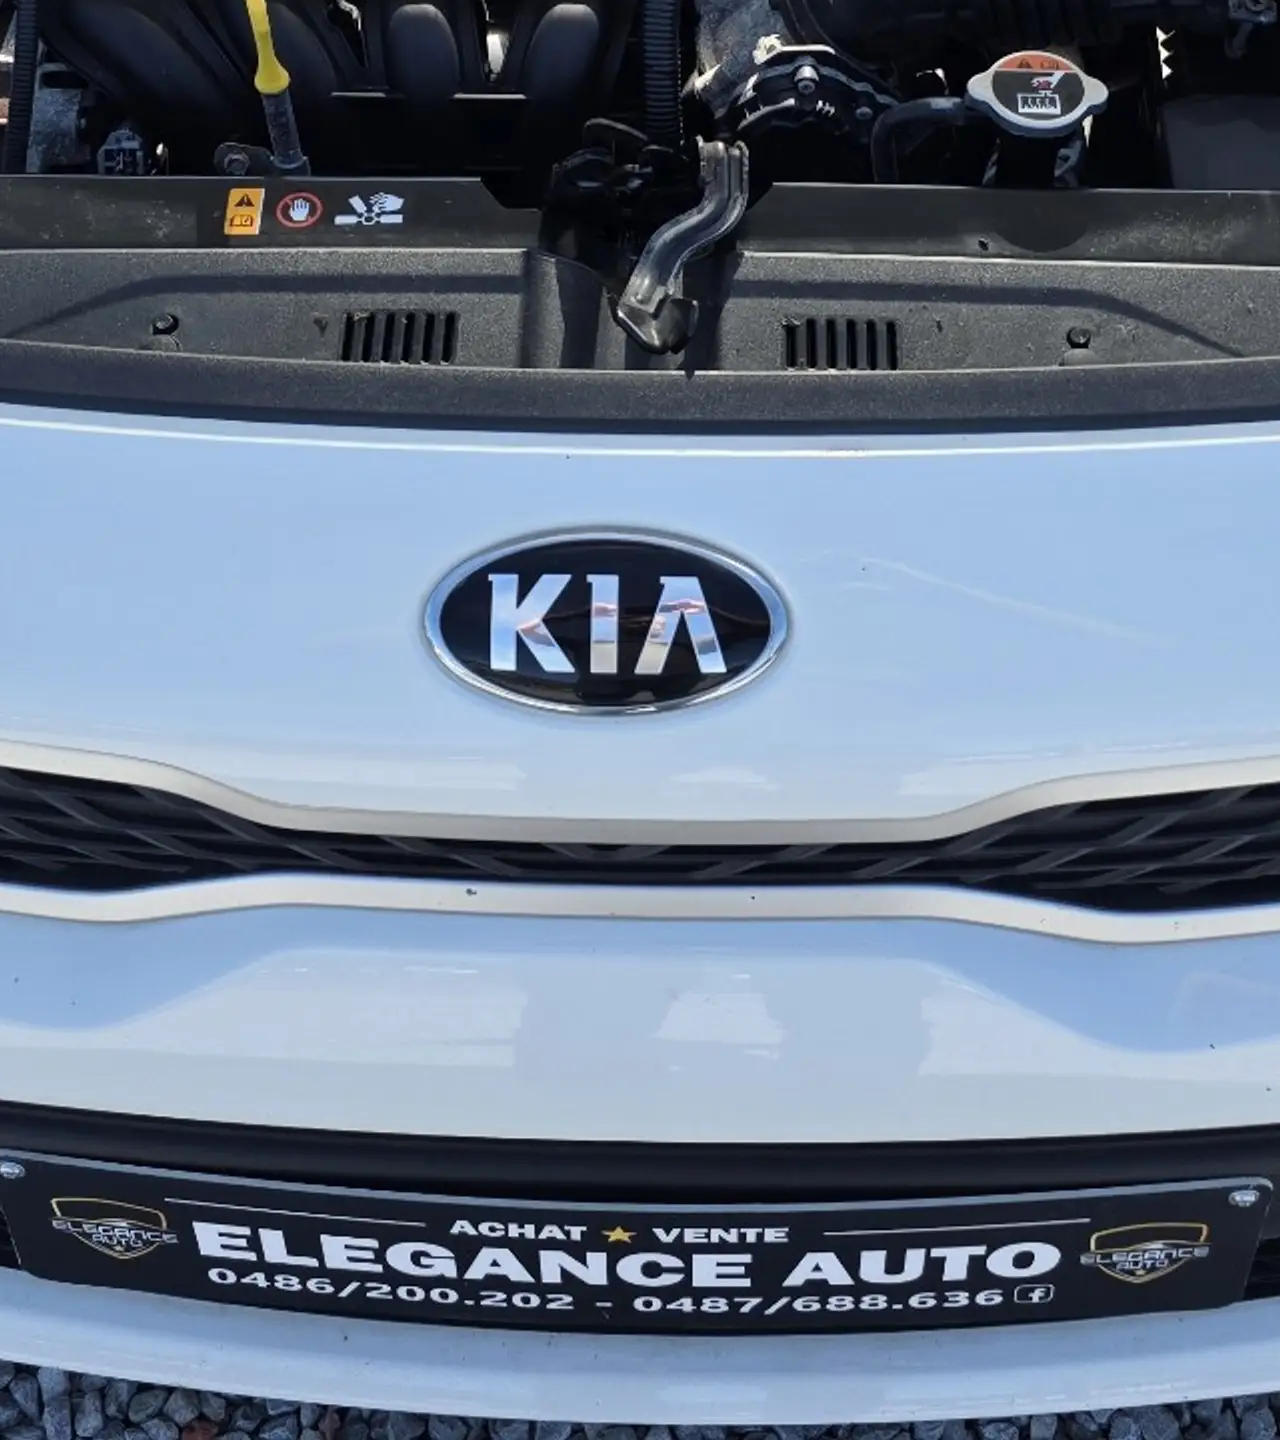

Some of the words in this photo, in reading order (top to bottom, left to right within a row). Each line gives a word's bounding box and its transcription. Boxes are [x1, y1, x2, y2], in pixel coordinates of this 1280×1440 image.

[488, 573, 727, 674] KIA
[192, 1221, 753, 1287] ELEGANCE
[782, 1241, 1062, 1288] AUTO
[450, 1219, 587, 1241] ACHAT
[652, 1227, 790, 1244] VENTE
[207, 1267, 575, 1310] 0486/200.202
[633, 1288, 1004, 1316] 0487/688.636
